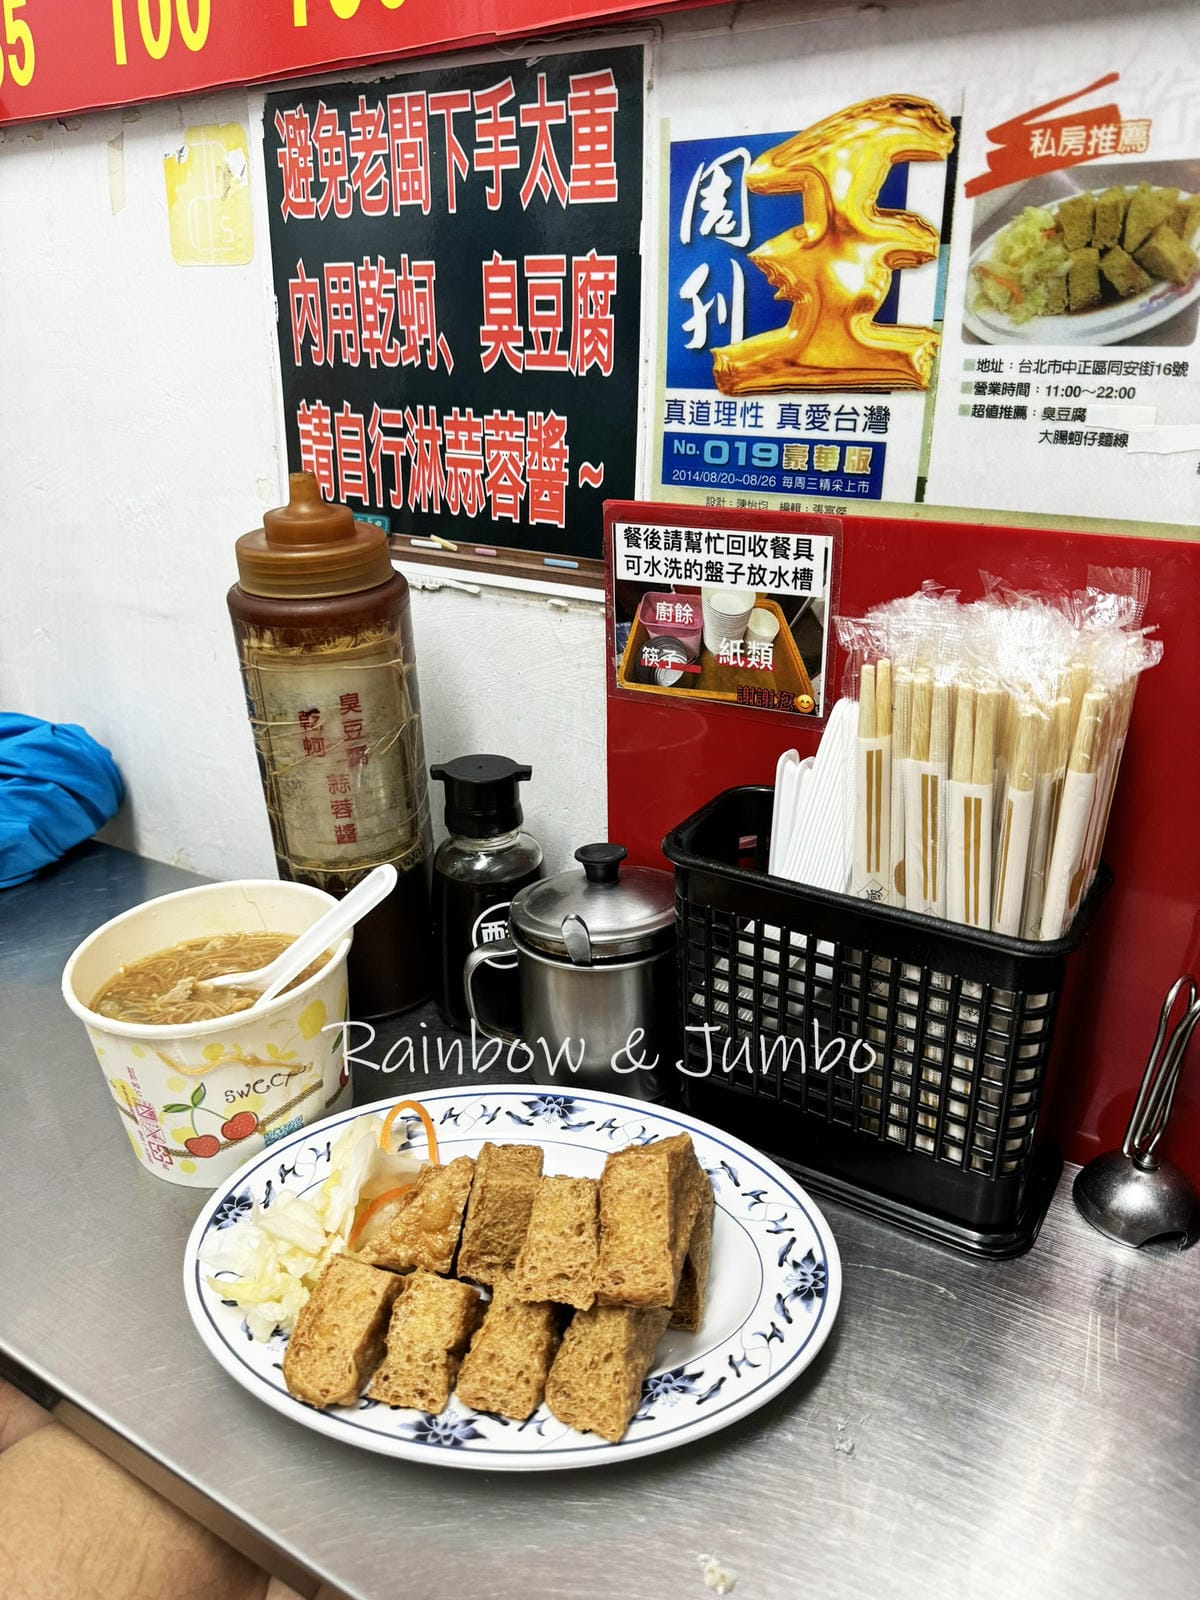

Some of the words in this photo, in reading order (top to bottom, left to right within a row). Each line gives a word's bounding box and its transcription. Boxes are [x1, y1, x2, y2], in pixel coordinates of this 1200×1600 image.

[0, 0, 35, 87] 5
[275, 68, 620, 223] 避免老闆下手太重
[1029, 119, 1152, 159] 私房推薦
[679, 146, 751, 350] 周刊
[664, 399, 764, 429] 真道理性
[776, 402, 891, 435] 真愛台灣
[1038, 429, 1129, 448] 大腸蚵仔麵線
[673, 439, 700, 455] No.
[703, 440, 779, 468] 019
[781, 443, 873, 475] 豪華版
[672, 469, 777, 488] 2014/08/20~08/26
[782, 476, 870, 494] 每周三精采上市
[623, 526, 814, 561] 餐後請幫忙回收餐具
[624, 554, 814, 591] 可水洗的盤子放水槽
[655, 601, 694, 625] 廚餘
[641, 646, 678, 669] 筷子
[718, 637, 774, 671] 紙類
[736, 686, 795, 711] 謝謝您
[298, 708, 327, 758] 乾蚵
[339, 692, 369, 768] 臭豆腐
[326, 773, 358, 844] 蒜蓉醬
